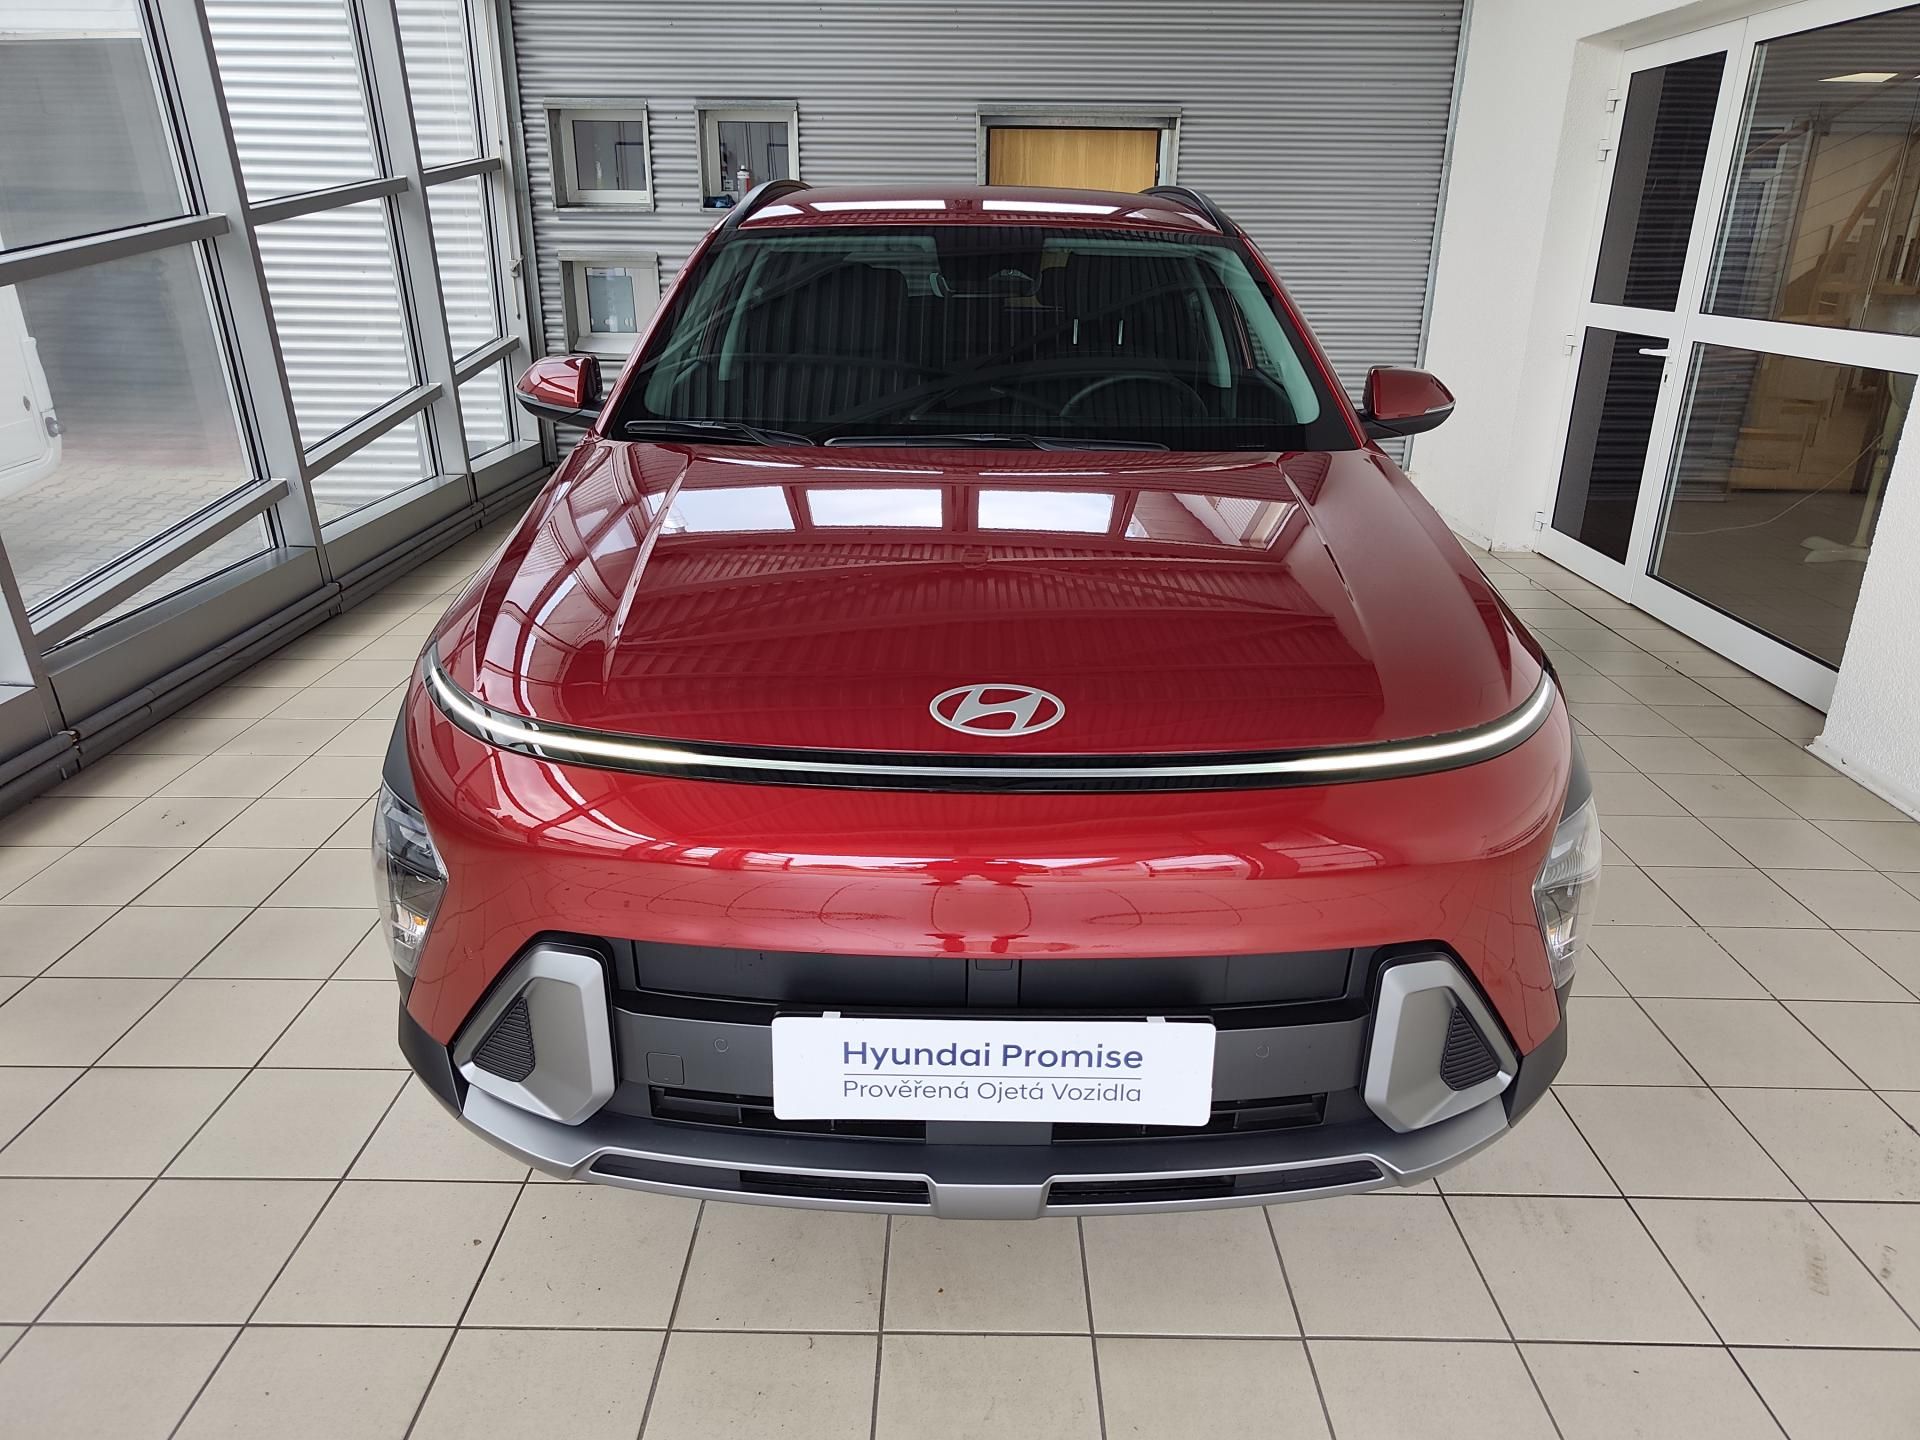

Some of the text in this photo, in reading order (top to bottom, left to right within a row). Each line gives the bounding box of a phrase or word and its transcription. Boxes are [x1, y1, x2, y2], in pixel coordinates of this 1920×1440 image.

[843, 1041, 1144, 1071] Hyundai Promise
[843, 1079, 1141, 1104] Prověřená Ojetá Vozidla
